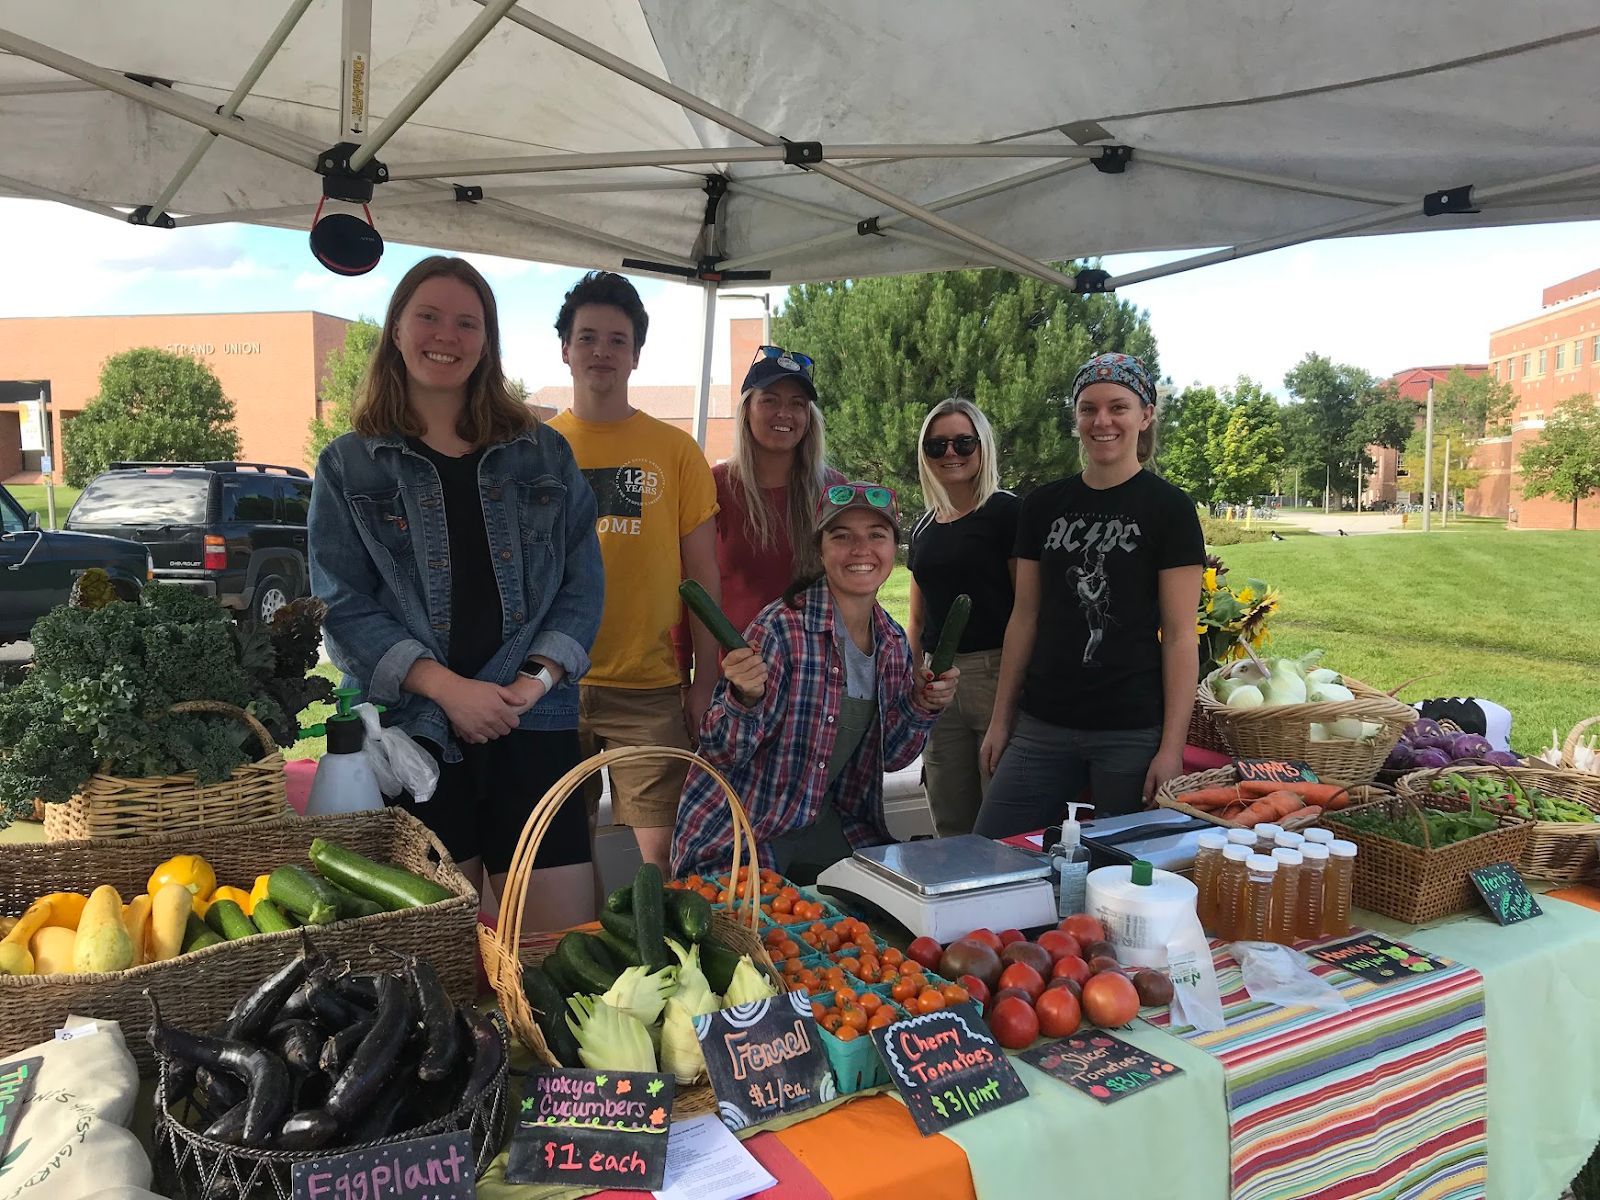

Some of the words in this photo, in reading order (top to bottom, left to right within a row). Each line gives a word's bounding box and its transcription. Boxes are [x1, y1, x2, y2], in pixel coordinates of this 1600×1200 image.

[223, 342, 261, 355] UNION
[624, 468, 658, 488] 125
[625, 484, 657, 496] YEARS
[1477, 871, 1512, 892] Herbs
[724, 1020, 811, 1080] Fennel
[900, 1028, 961, 1061] Cherry
[909, 1047, 994, 1083] Tomatoes
[1060, 1047, 1111, 1071] Slicer
[1071, 1055, 1145, 1083] Tomatoes
[540, 1094, 647, 1118] Cucumbers
[544, 1141, 583, 1170] $1
[589, 1150, 646, 1175] each
[307, 1144, 465, 1200] Eggplant
